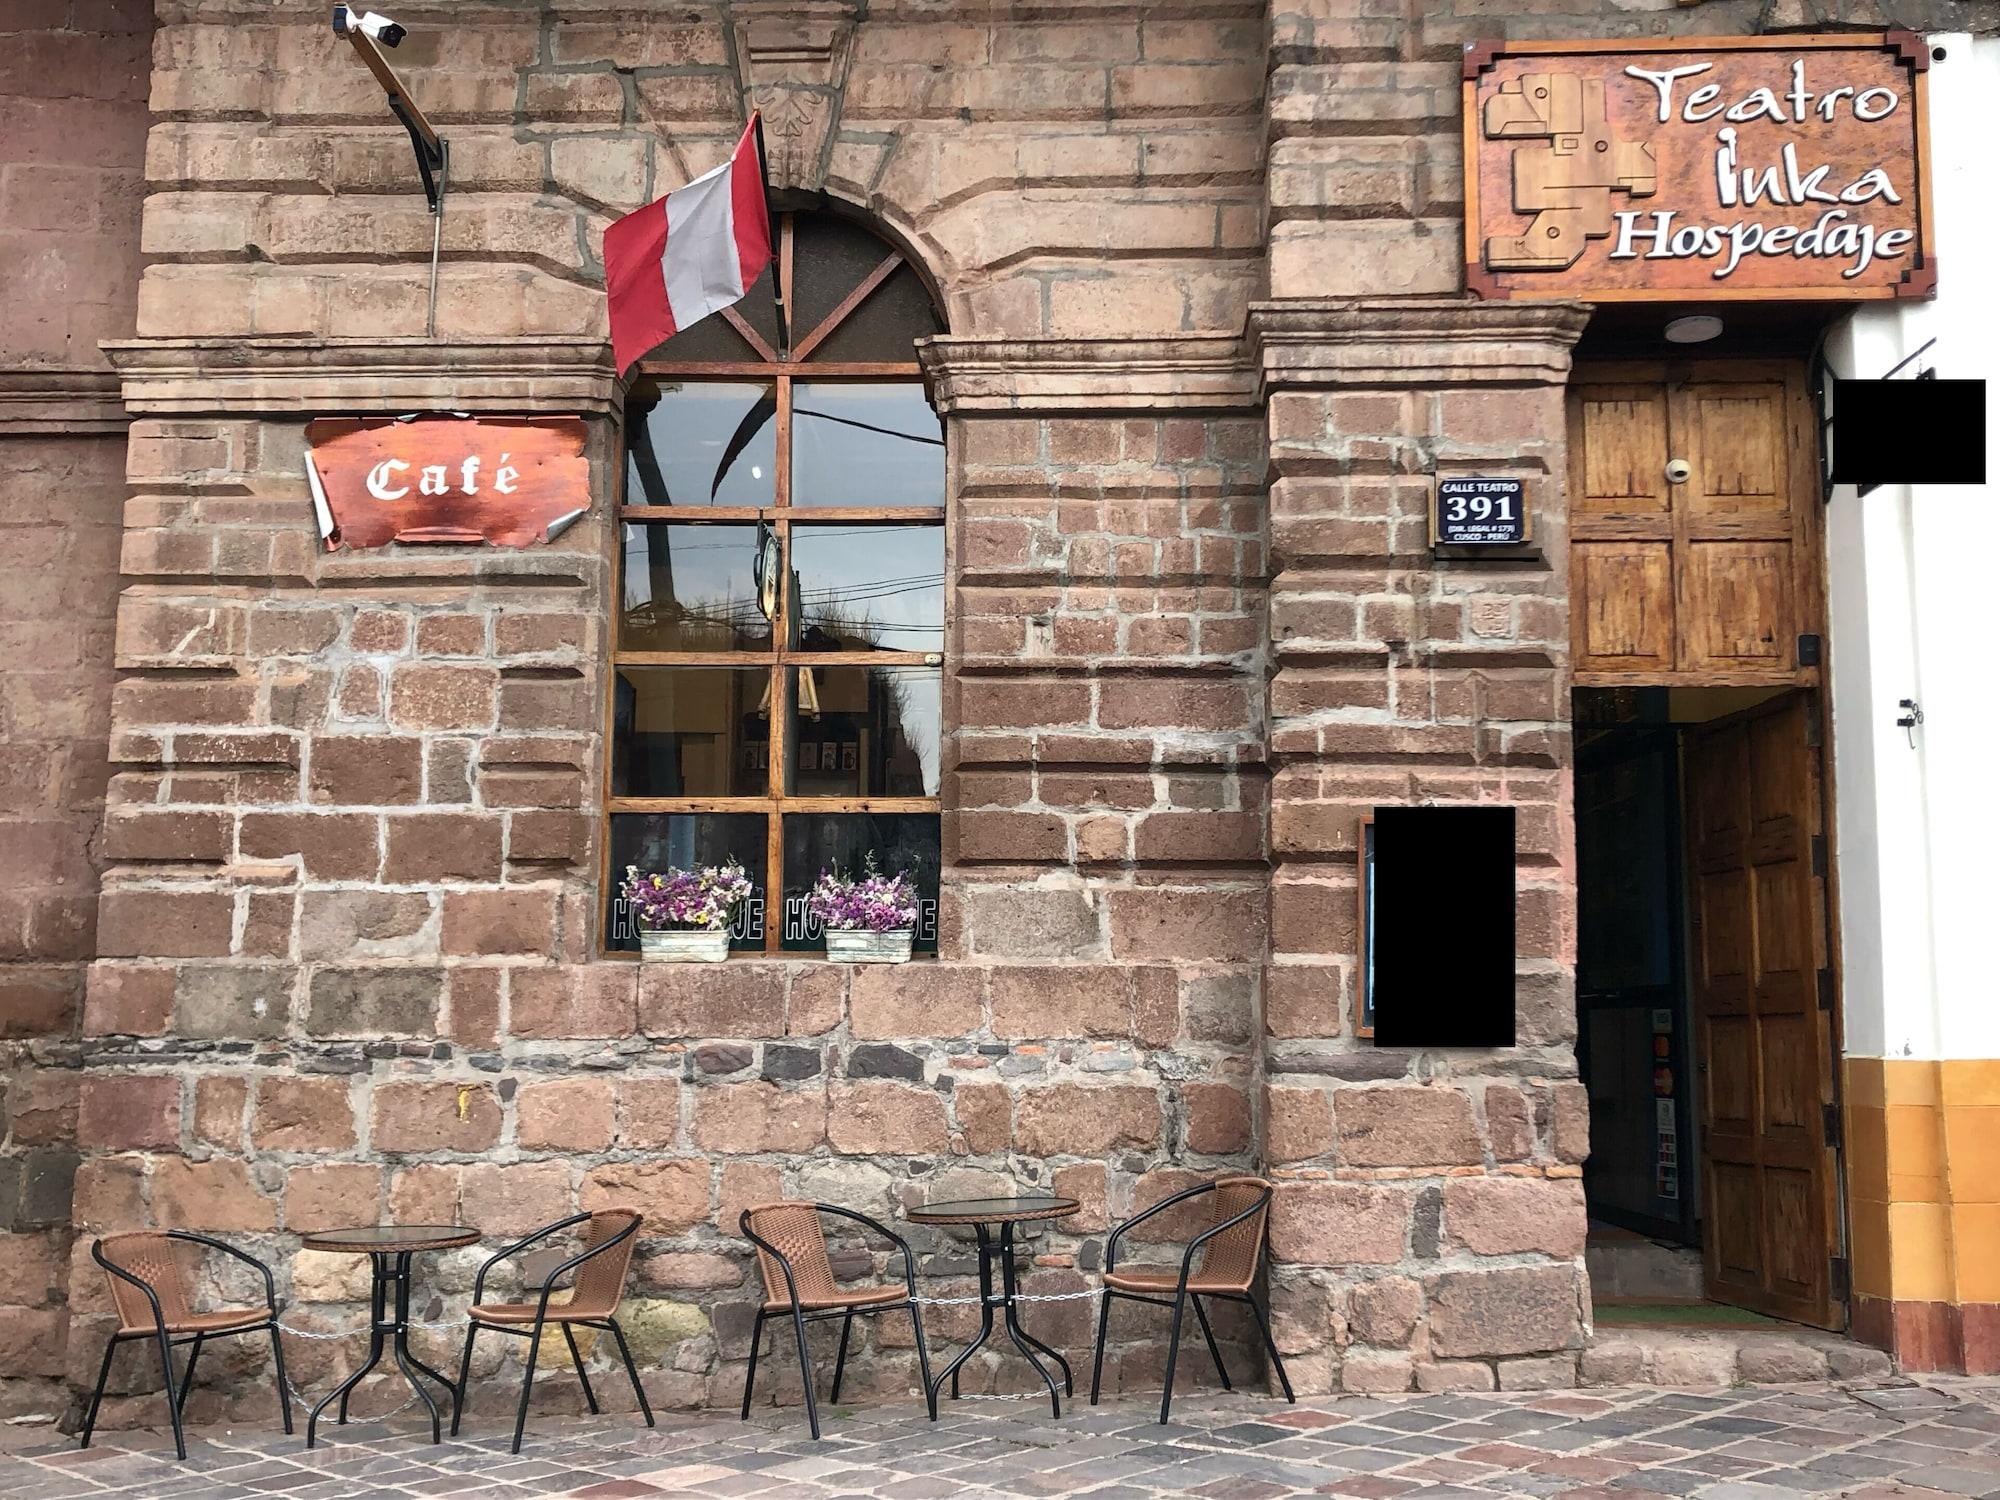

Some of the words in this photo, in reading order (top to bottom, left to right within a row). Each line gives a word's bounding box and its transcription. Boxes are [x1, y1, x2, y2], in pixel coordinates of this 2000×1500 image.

[1624, 58, 1899, 123] Teatro
[1608, 209, 1914, 279] Hospedaje
[366, 453, 520, 501] Café
[1442, 483, 1475, 493] CALLE
[1477, 482, 1519, 493] TEATRO
[1446, 496, 1516, 521] 391
[1468, 525, 1490, 533] LEGAL
[1487, 532, 1510, 540] PERÚ
